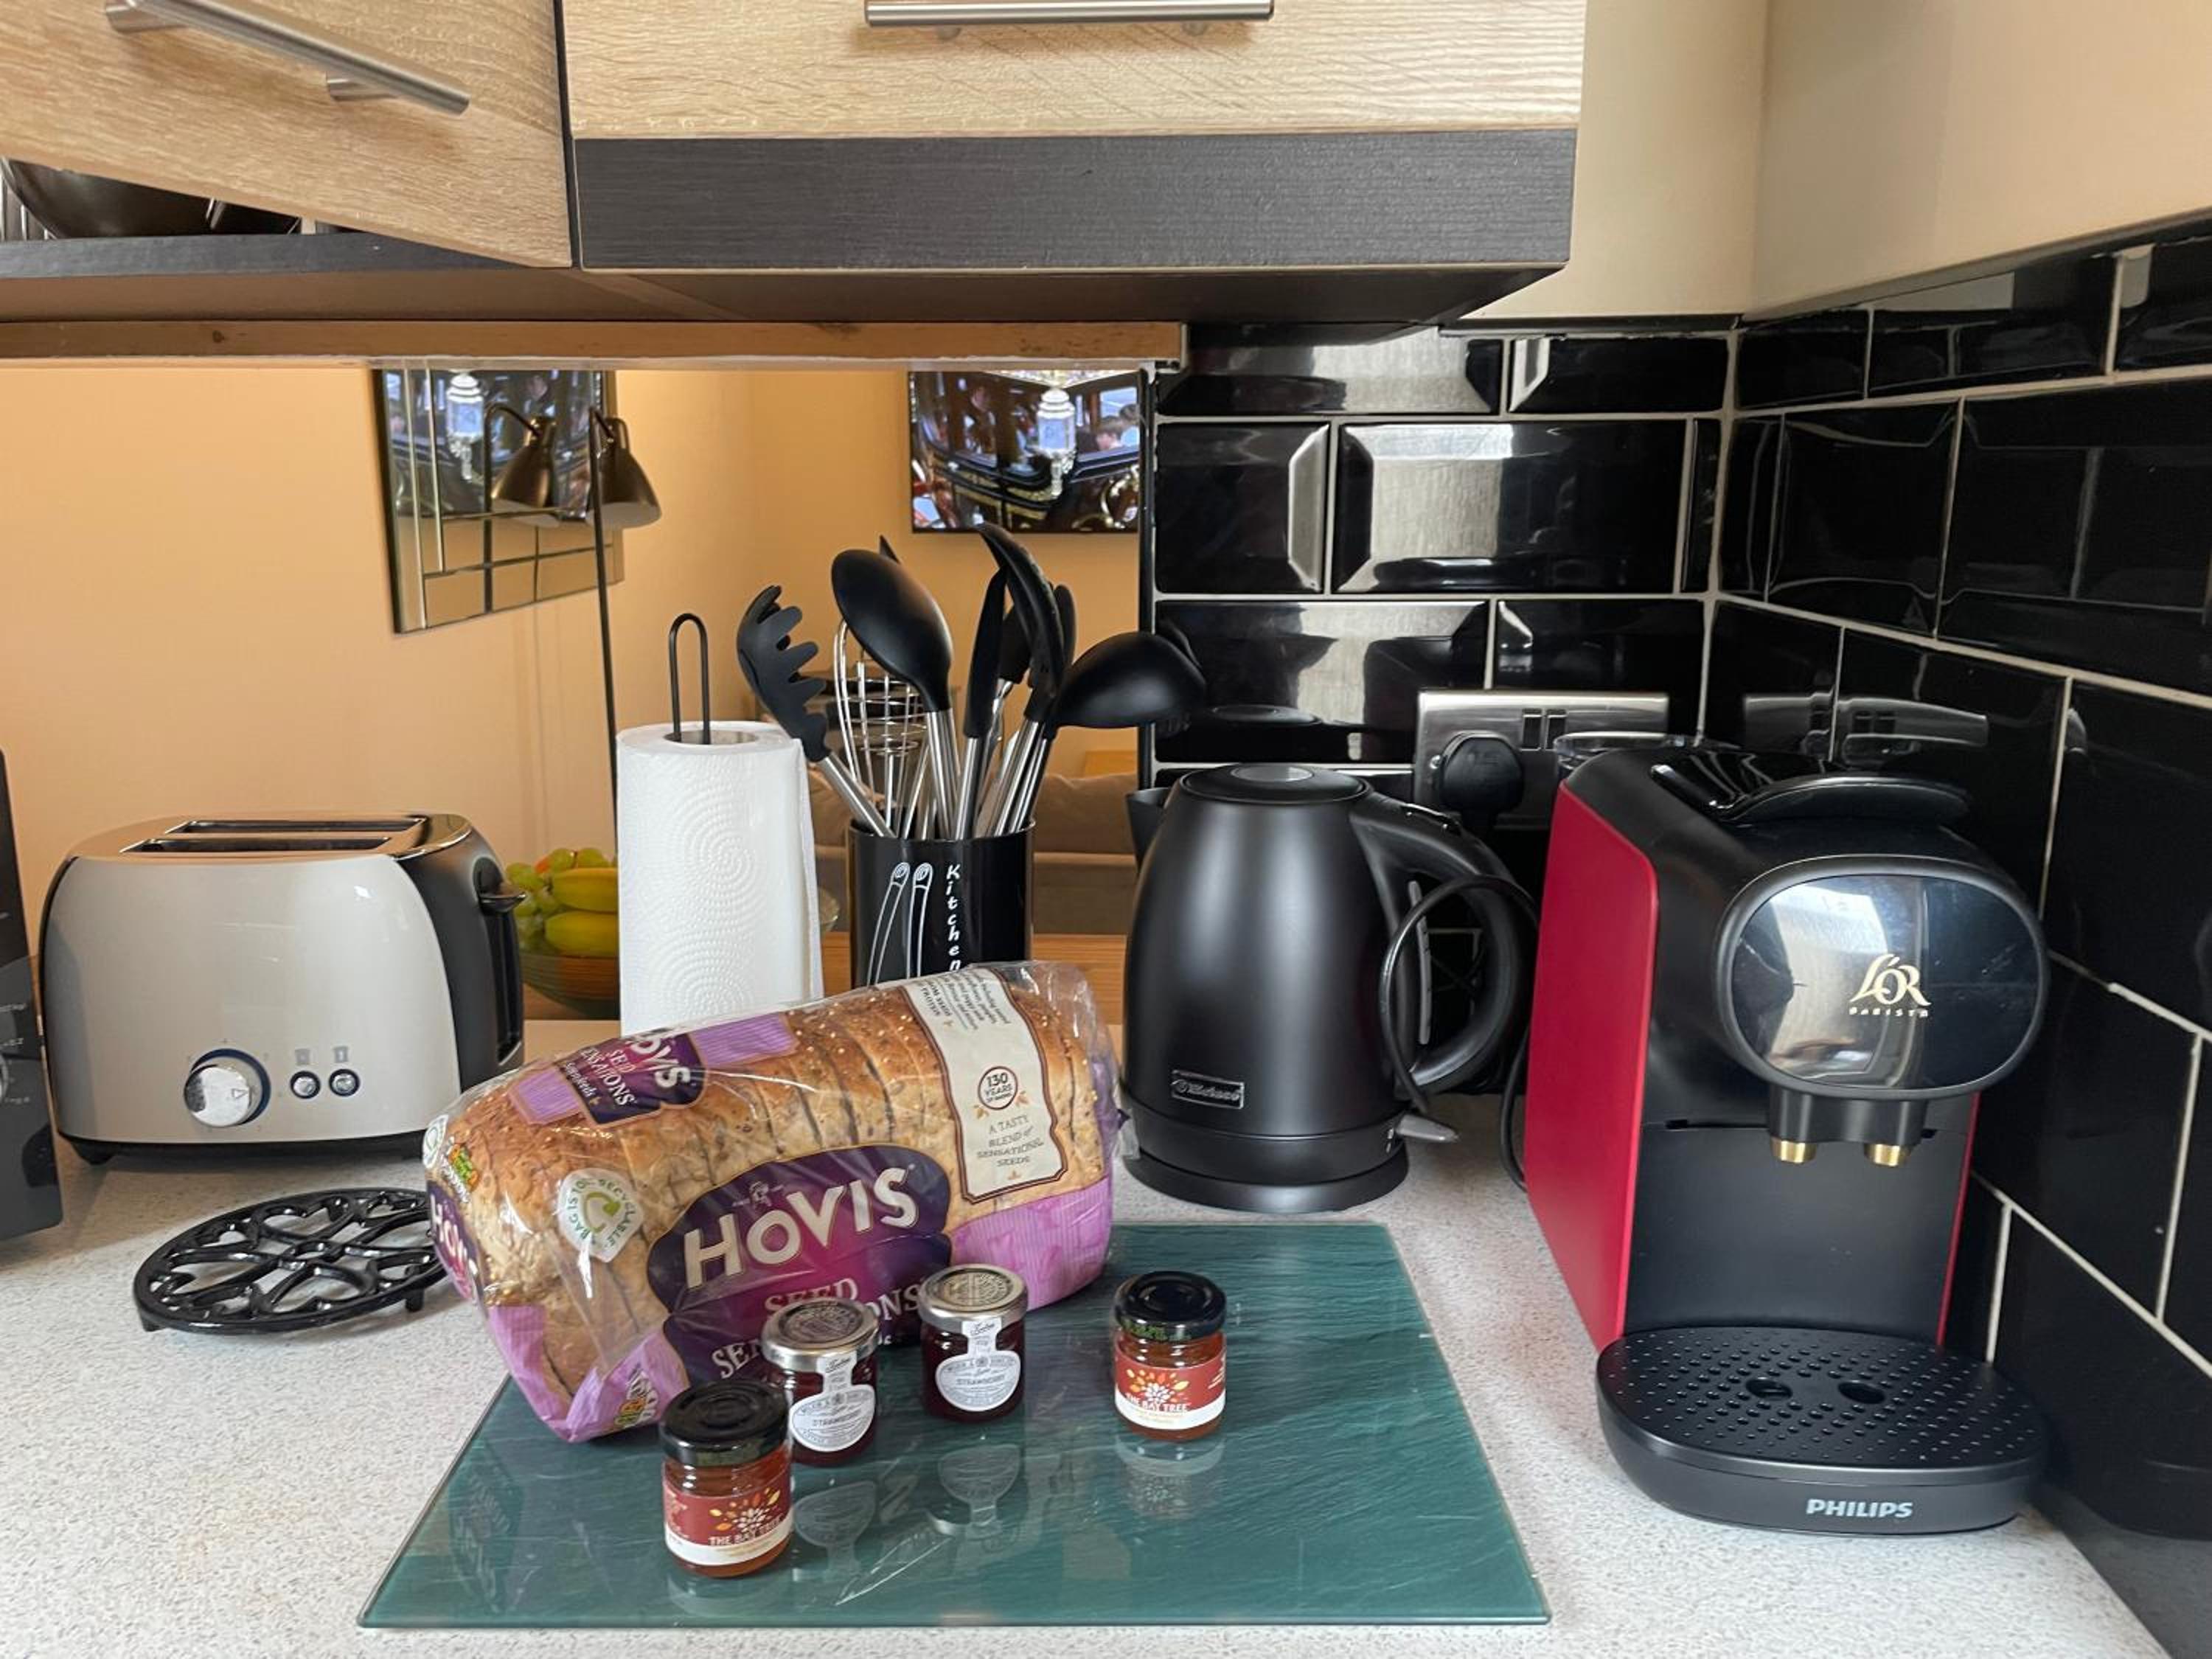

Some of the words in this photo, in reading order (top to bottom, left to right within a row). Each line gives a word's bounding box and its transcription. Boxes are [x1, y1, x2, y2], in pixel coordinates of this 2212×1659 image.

[946, 863, 961, 971] Kitchen
[987, 1071, 1009, 1088] 130
[984, 1083, 1013, 1096] YEARS
[998, 1114, 1029, 1132] TASTY
[989, 1131, 1022, 1148] BLEND
[684, 1166, 919, 1290] HOVIS
[1141, 1400, 1162, 1412] BAY
[1163, 1403, 1188, 1413] TREE
[1806, 1498, 1913, 1518] PHILIPS
[709, 1535, 733, 1546] THE
